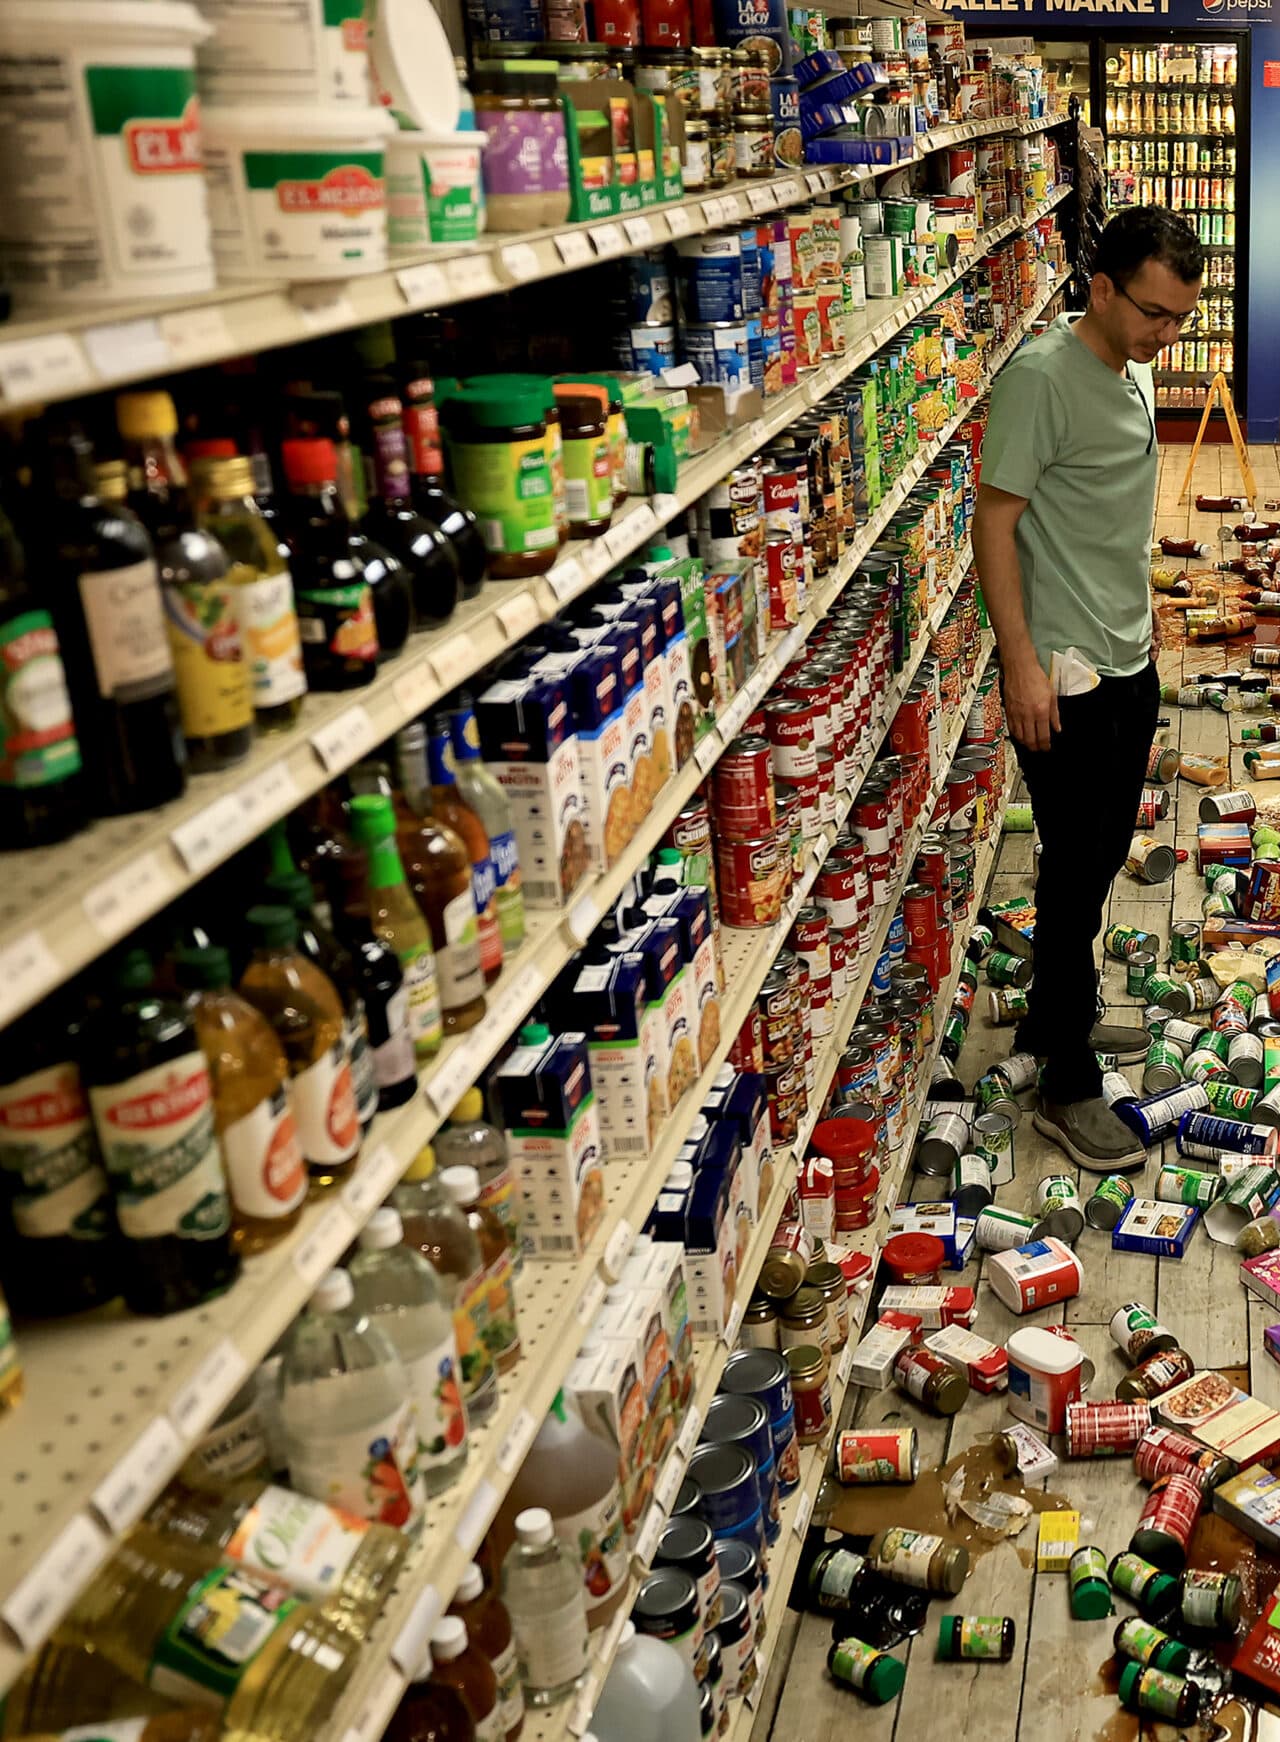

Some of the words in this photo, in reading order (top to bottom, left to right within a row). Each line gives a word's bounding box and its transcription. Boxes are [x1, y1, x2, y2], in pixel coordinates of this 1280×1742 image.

[1046, 0, 1169, 13] MARKET
[738, 11, 769, 25] CHOY
[780, 105, 799, 118] CHO
[776, 720, 814, 735] Campb
[868, 862, 891, 873] Camp
[798, 928, 829, 943] Campb
